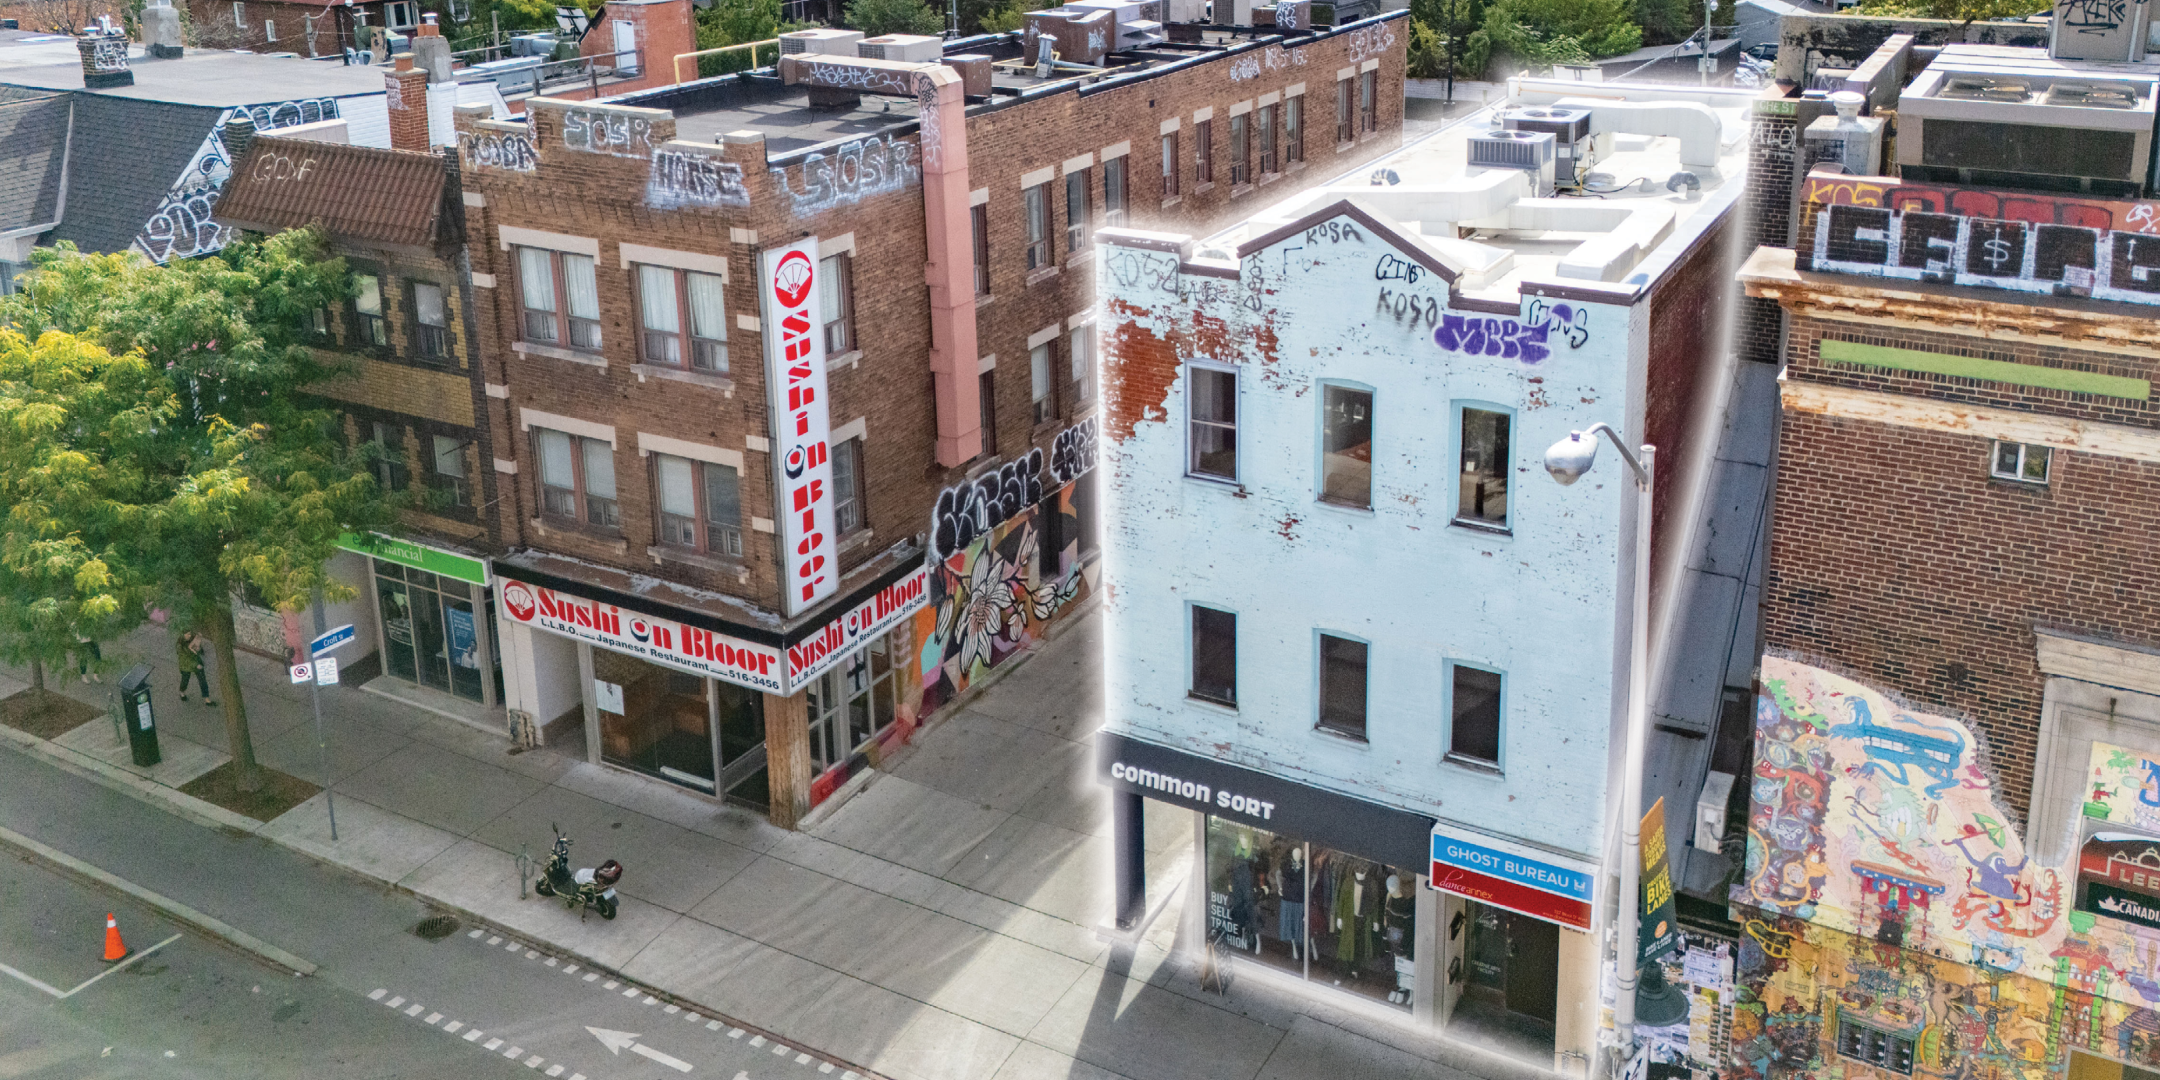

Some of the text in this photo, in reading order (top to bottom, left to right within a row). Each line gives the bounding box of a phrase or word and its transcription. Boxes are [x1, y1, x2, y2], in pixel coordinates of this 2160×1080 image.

[1306, 221, 1366, 245] KOSA
[781, 308, 815, 437] Sushi
[793, 478, 825, 603] Bloor
[537, 586, 621, 636] Sushi
[681, 623, 776, 676] Bloor
[788, 615, 844, 678] Sushi
[875, 571, 926, 621] Bloor
[323, 635, 338, 647] Croft
[541, 617, 780, 690] L.L.B.O. Japanese Restaurant 516-3456
[791, 593, 927, 688] L.L.B.O. Japanese Restaurant 516-3456
[1447, 845, 1569, 888] GHOST BUREAU
[1211, 892, 1229, 906] BUY
[1647, 872, 1671, 905] BIKE
[1647, 887, 1672, 915] LANES
[1211, 904, 1232, 920] SELL
[1211, 916, 1239, 935] TRADE
[2119, 902, 2160, 922] CANADI
[1211, 930, 1249, 950] HION
